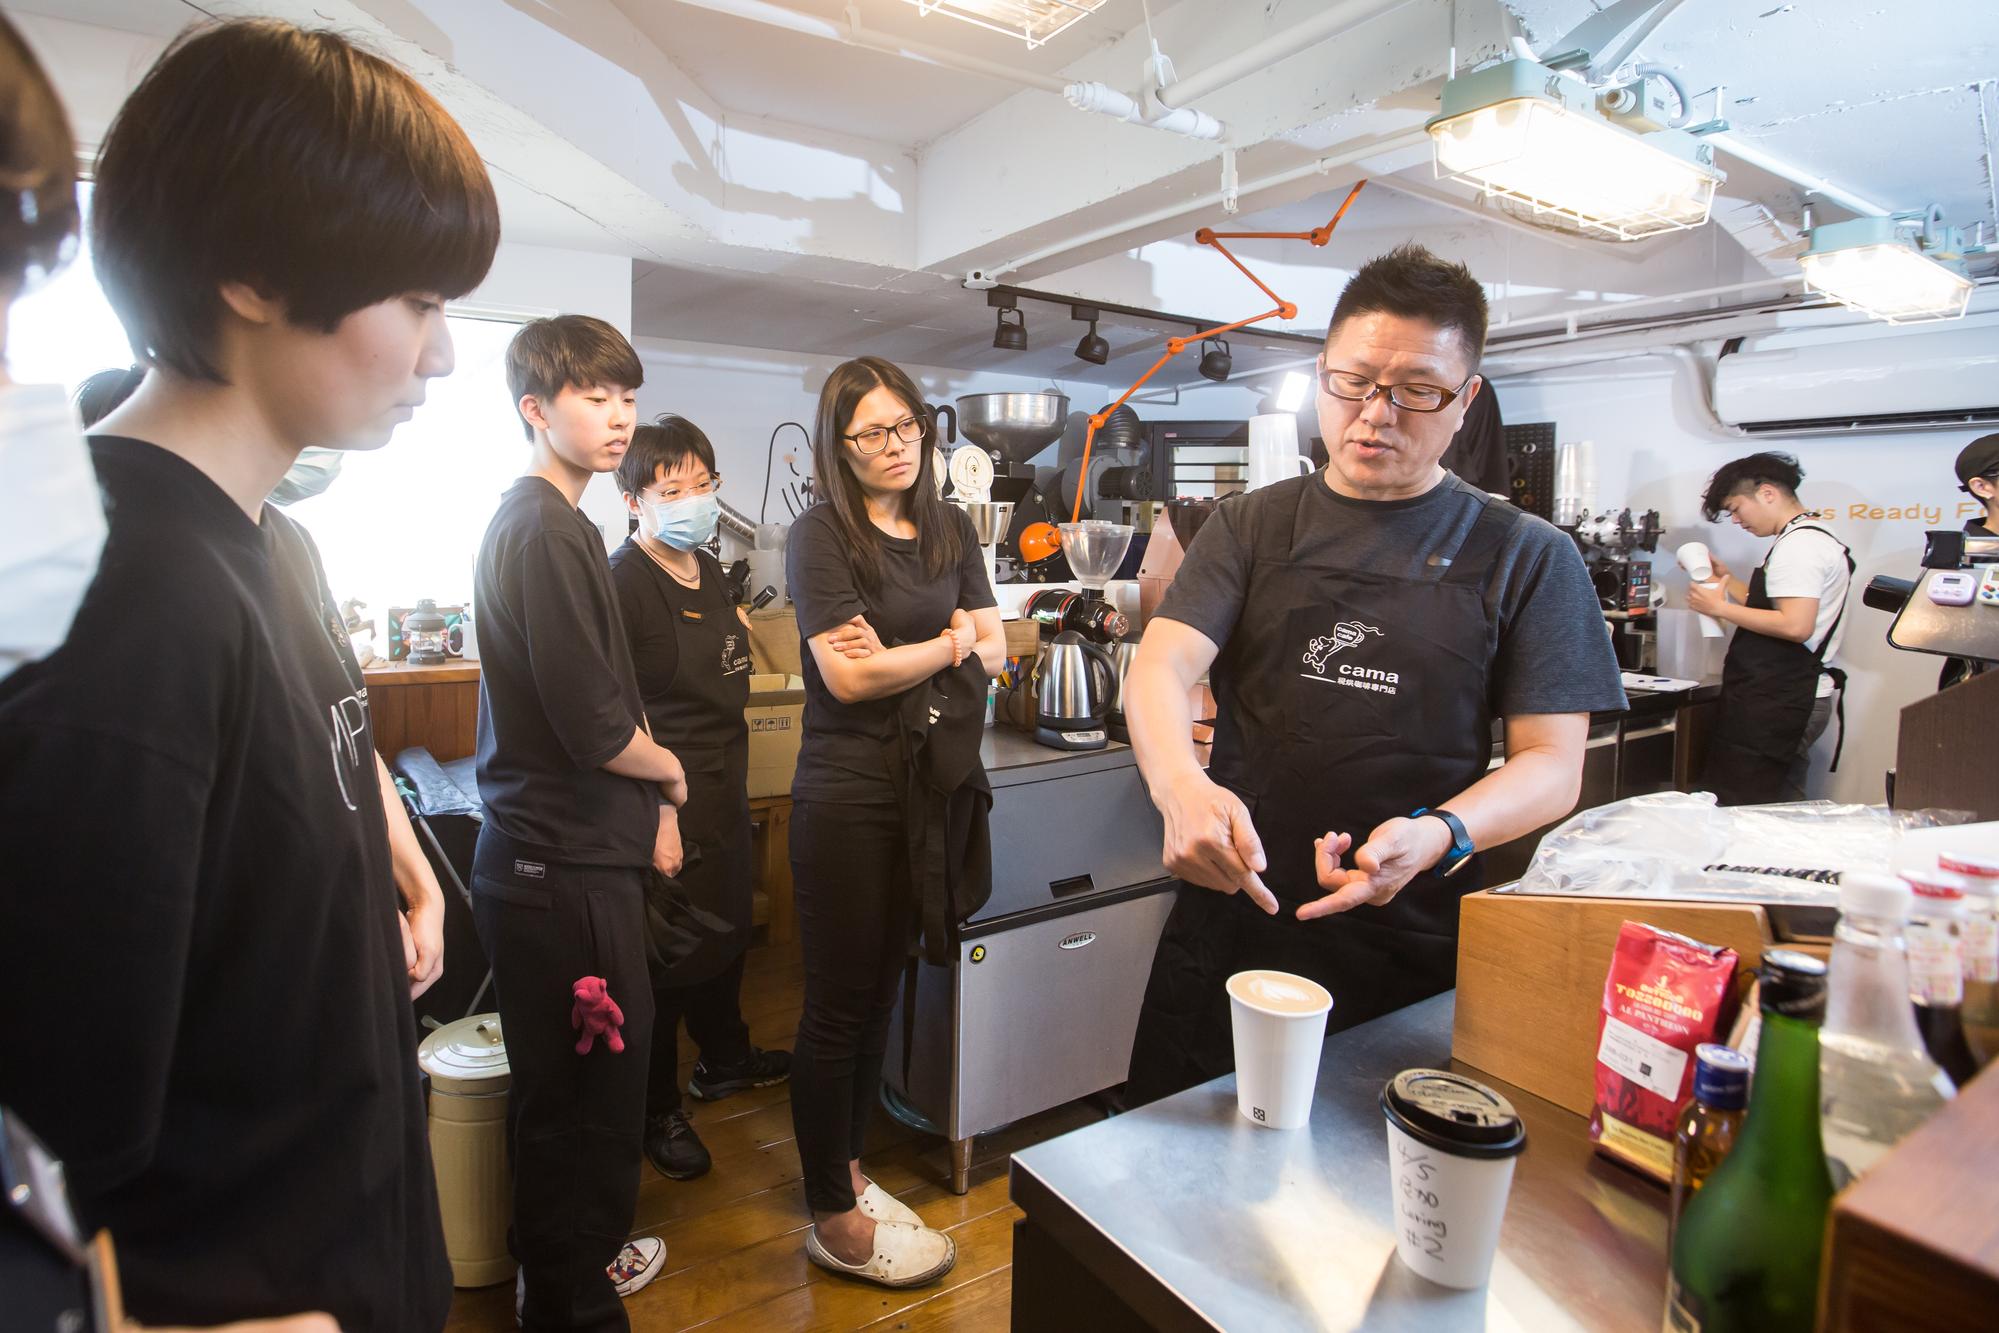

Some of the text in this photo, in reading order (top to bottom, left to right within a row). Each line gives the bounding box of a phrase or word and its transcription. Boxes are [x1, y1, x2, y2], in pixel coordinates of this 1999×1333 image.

[1849, 503, 1942, 525] Ready
[1339, 664, 1399, 684] cama
[1062, 933, 1093, 946] ANWELL
